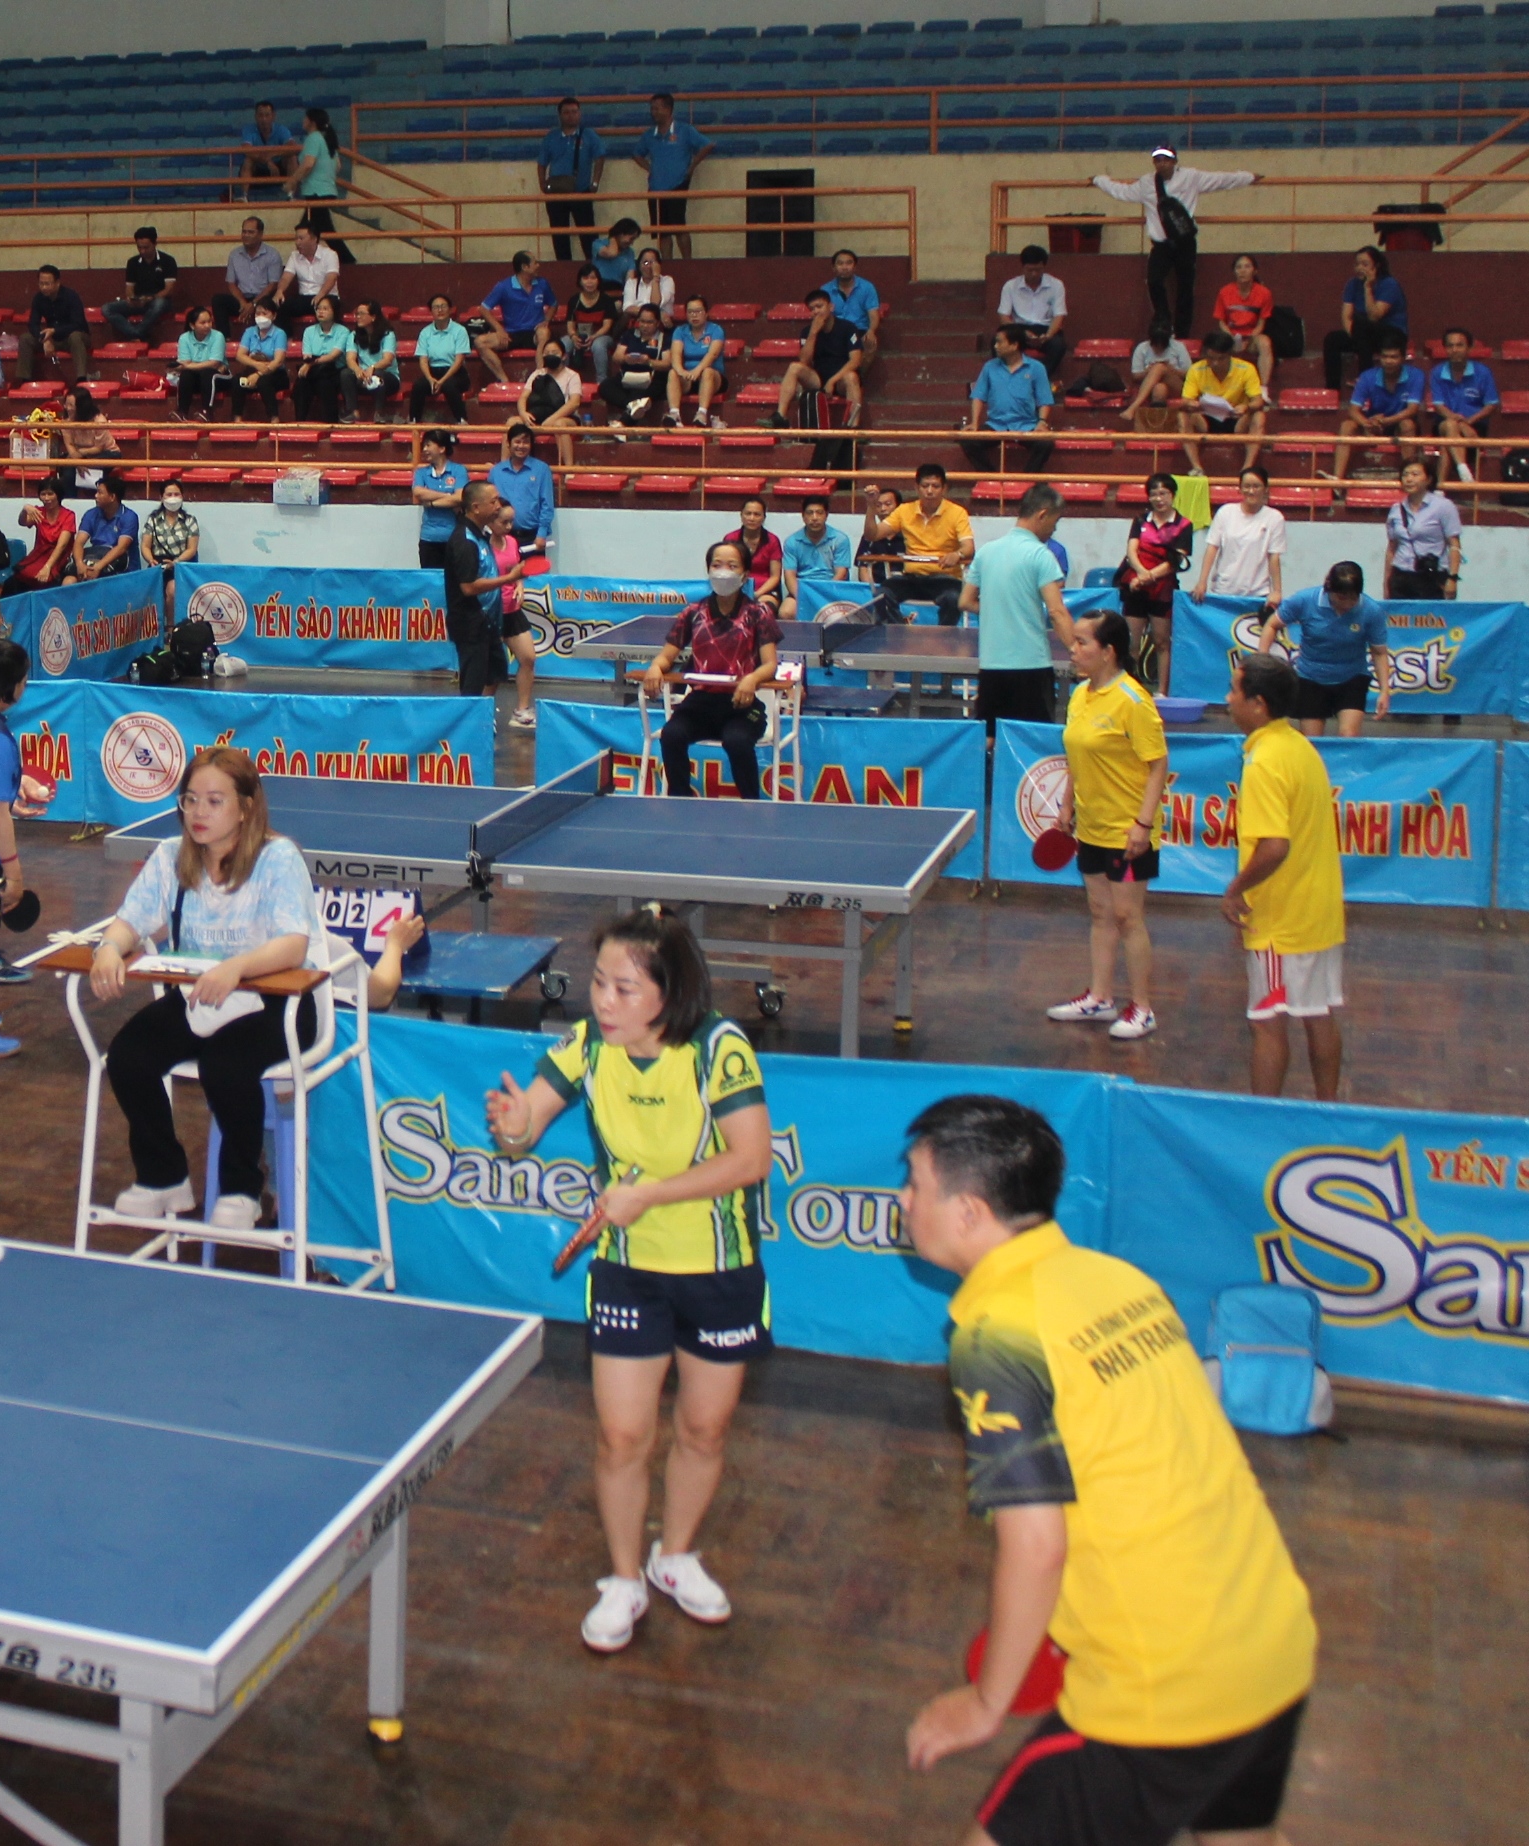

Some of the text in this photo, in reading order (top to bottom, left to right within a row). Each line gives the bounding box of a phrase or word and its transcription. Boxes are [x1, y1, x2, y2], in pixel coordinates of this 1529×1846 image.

[72, 608, 92, 660] YẾN
[93, 609, 111, 654] SÀO
[252, 591, 447, 642] YẾN SÀO KHÁNH HÒA
[20, 720, 73, 782] HÒA
[315, 739, 410, 784] KHÁNH
[416, 740, 473, 786] HÒA
[1201, 781, 1239, 849] SÀ
[1400, 790, 1471, 860] HÒA
[315, 860, 434, 882] MOFIT
[351, 903, 365, 924] 2
[831, 896, 863, 911] 235
[1424, 1138, 1511, 1189] YẾN
[698, 1324, 757, 1347] XIOM
[1088, 1341, 1141, 1386] NHA
[56, 1656, 117, 1693] 235
